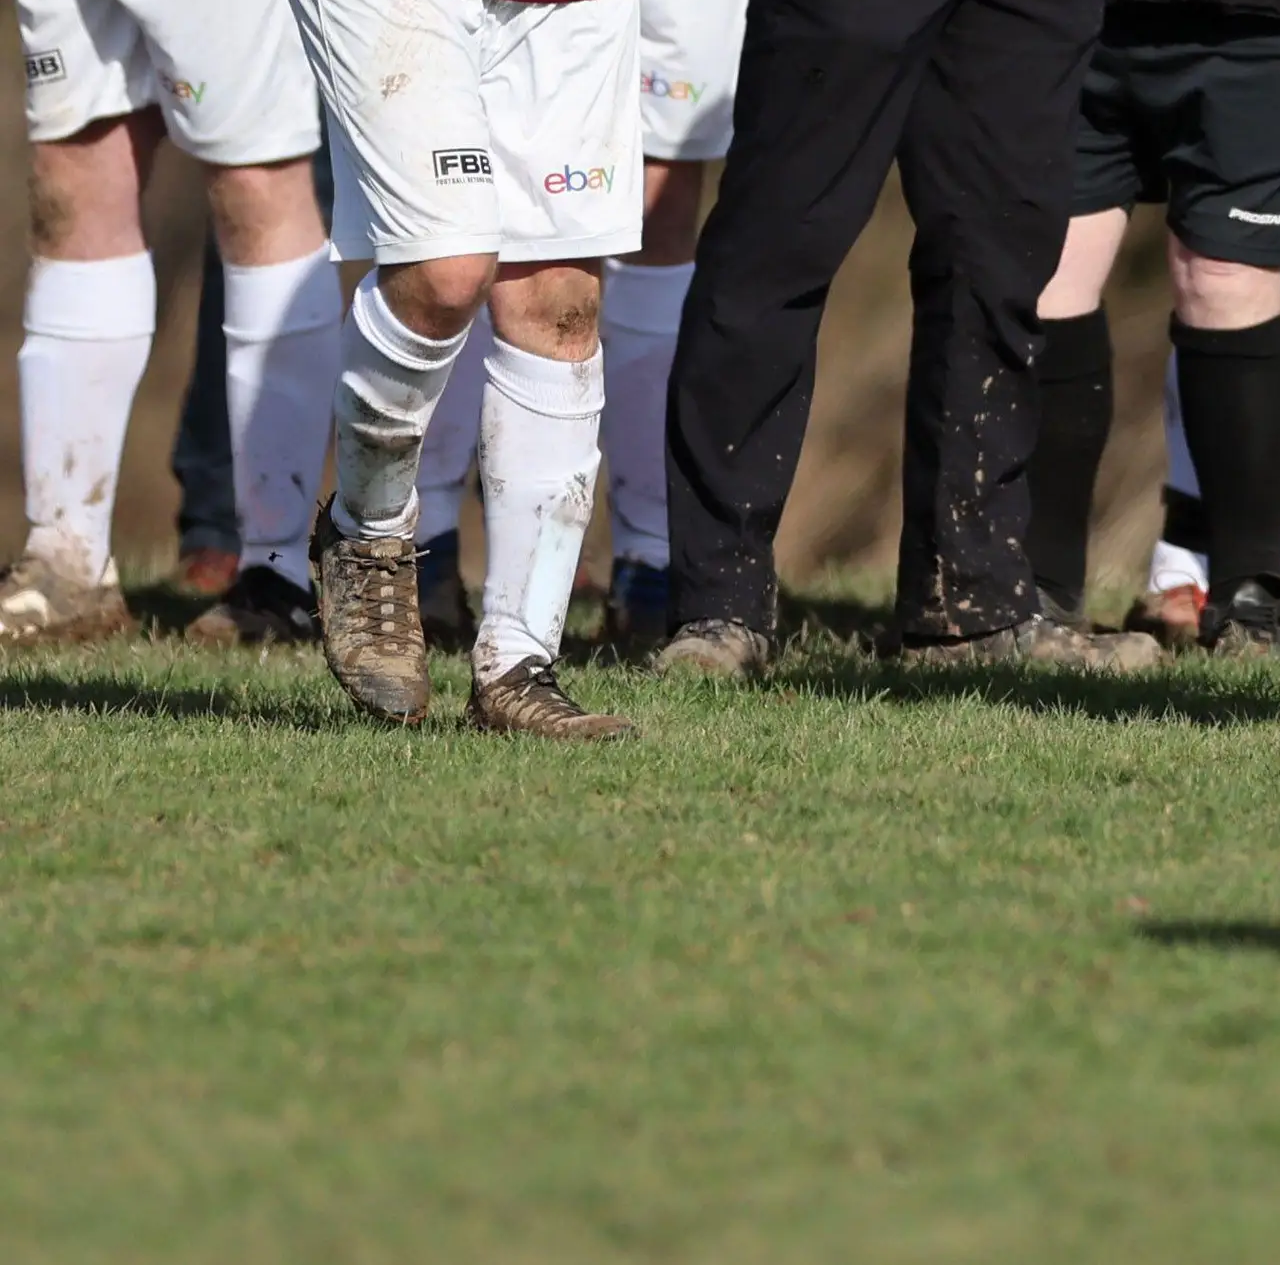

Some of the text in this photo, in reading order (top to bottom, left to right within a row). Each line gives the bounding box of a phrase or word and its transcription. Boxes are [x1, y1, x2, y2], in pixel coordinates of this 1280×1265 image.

[26, 55, 60, 79] BB
[439, 154, 492, 176] FBB
[543, 164, 615, 195] ebay
